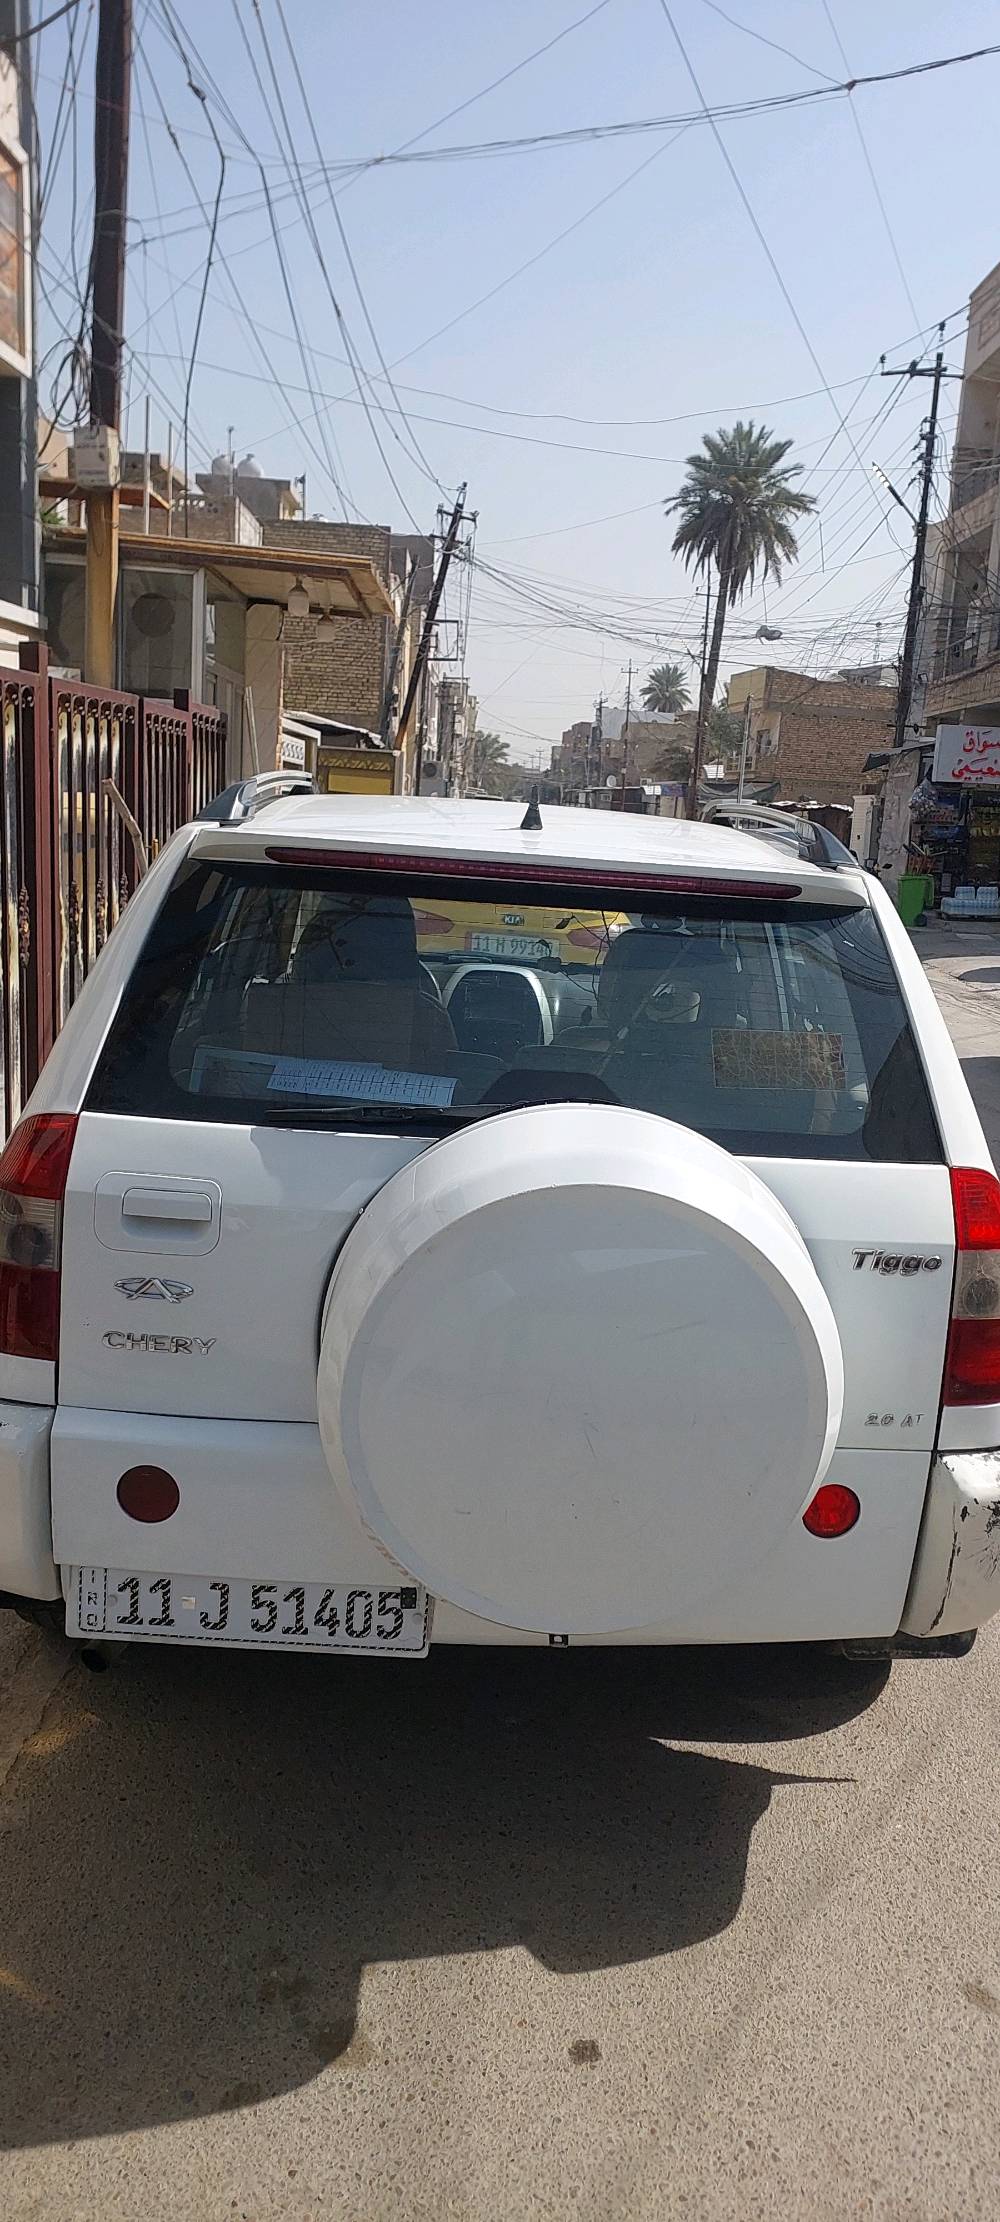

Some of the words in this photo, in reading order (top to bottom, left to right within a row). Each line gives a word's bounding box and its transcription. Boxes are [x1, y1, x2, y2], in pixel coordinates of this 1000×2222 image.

[963, 729, 1000, 753] سواق
[503, 914, 522, 925] KIA
[473, 934, 490, 952] 11
[496, 936, 505, 953] H
[852, 1248, 943, 1277] Tiggo
[101, 1330, 217, 1355] CHERY
[900, 1413, 926, 1427] AT
[117, 1576, 175, 1626] 11
[199, 1582, 230, 1631] J
[250, 1584, 405, 1640] 51405
